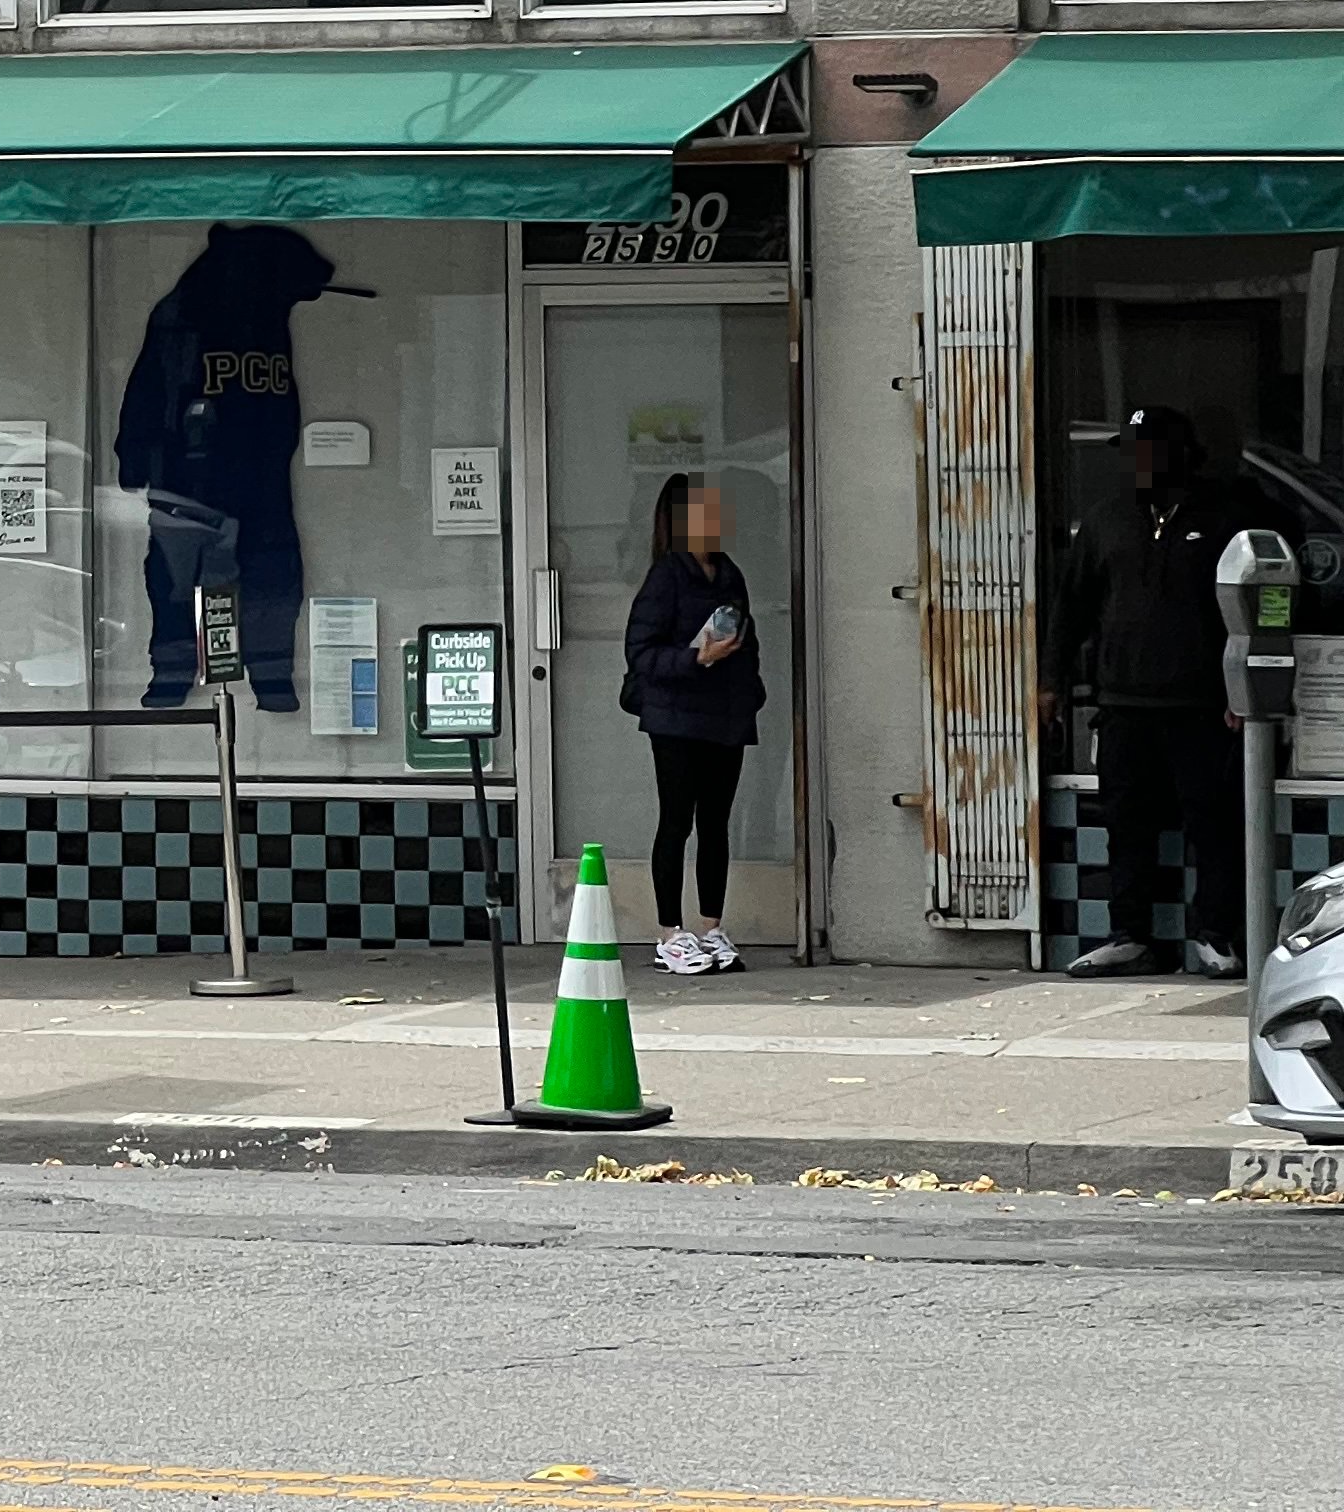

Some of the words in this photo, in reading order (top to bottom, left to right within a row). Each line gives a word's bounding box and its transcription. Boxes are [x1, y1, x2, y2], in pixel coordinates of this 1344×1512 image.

[586, 191, 729, 235] 90
[585, 235, 713, 262] 2590
[204, 351, 289, 395] PCC
[455, 461, 476, 471] ALL
[447, 473, 483, 484] SALES
[454, 487, 477, 497] ARE
[449, 500, 484, 510] FINAL
[430, 632, 491, 650] Curbside
[435, 653, 465, 669] Pick
[466, 652, 487, 671] Up
[441, 675, 480, 696] PCC
